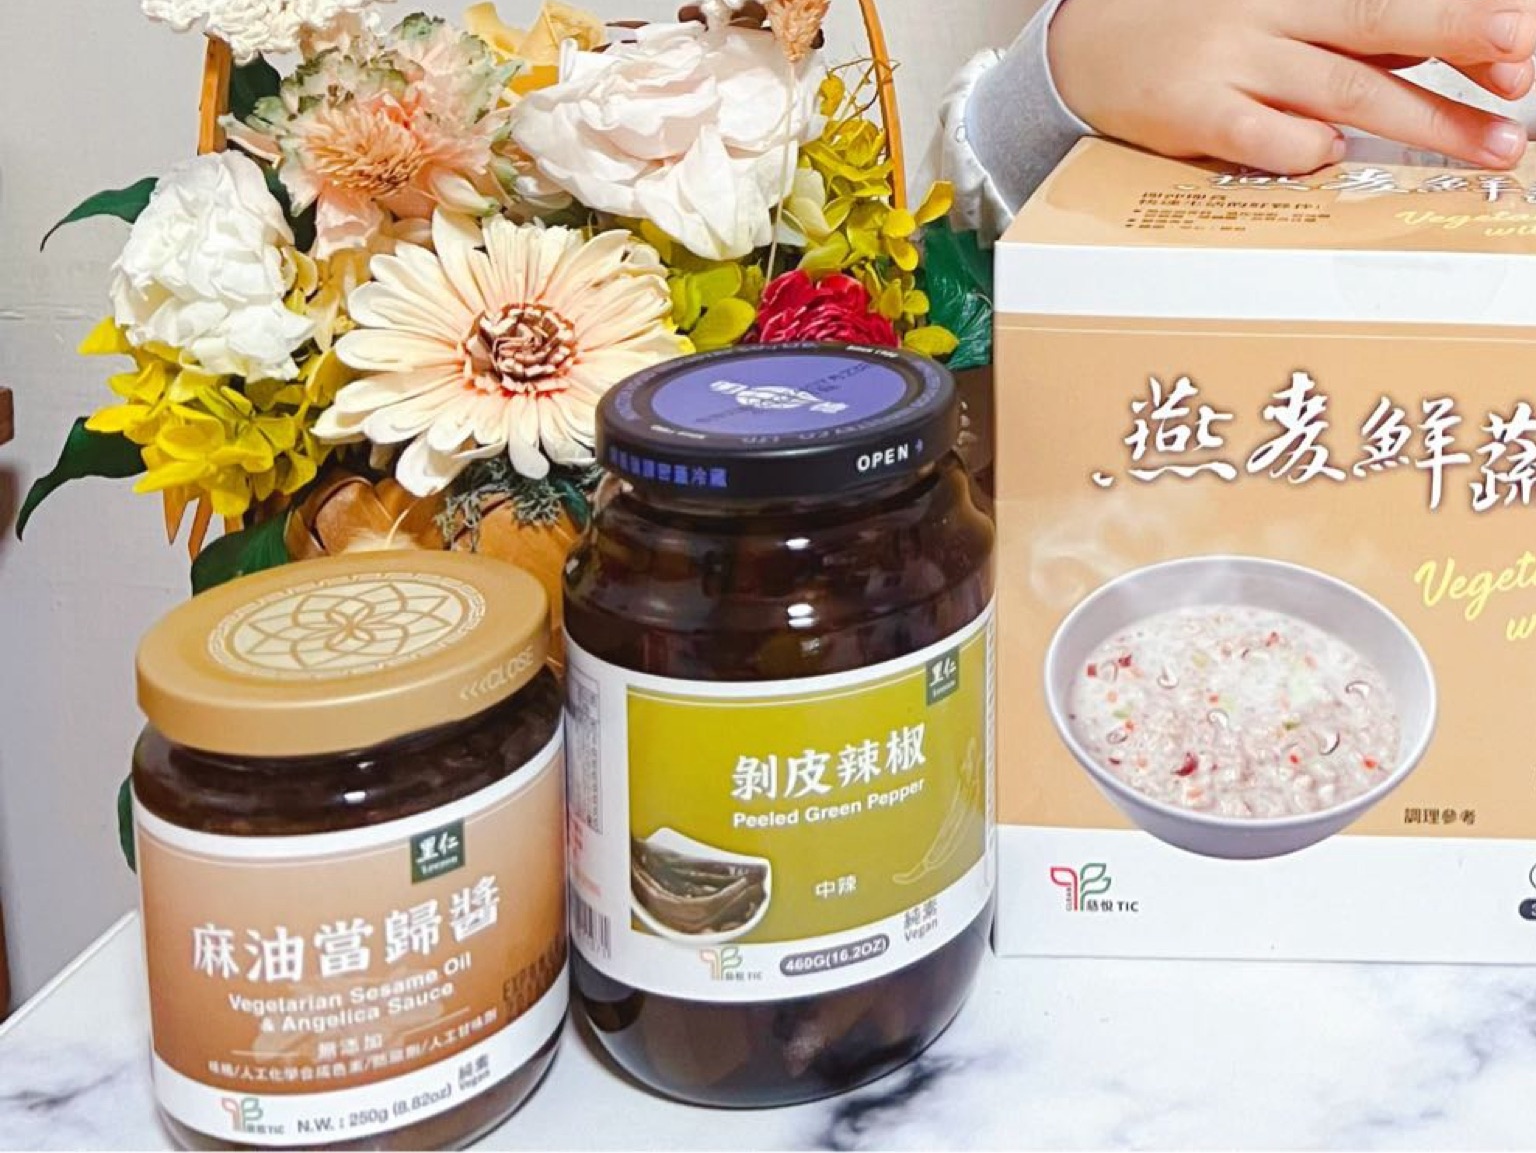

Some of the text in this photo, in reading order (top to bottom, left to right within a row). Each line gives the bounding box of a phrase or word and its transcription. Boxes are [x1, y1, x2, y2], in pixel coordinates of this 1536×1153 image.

[856, 442, 910, 474] OPEN
[733, 777, 926, 829] Peeled Green Pepper
[415, 831, 459, 864] 里仁
[815, 874, 857, 899] 中辣
[1116, 900, 1140, 913] TIC
[191, 874, 501, 983] 麻油當歸醬
[903, 917, 939, 943] Vegan
[227, 951, 472, 1018] Vegetarian Sesame Oil
[261, 981, 454, 1034] & Angelica Sauce
[349, 1106, 389, 1128] 250g
[391, 1082, 453, 1119] (8.82oz)
